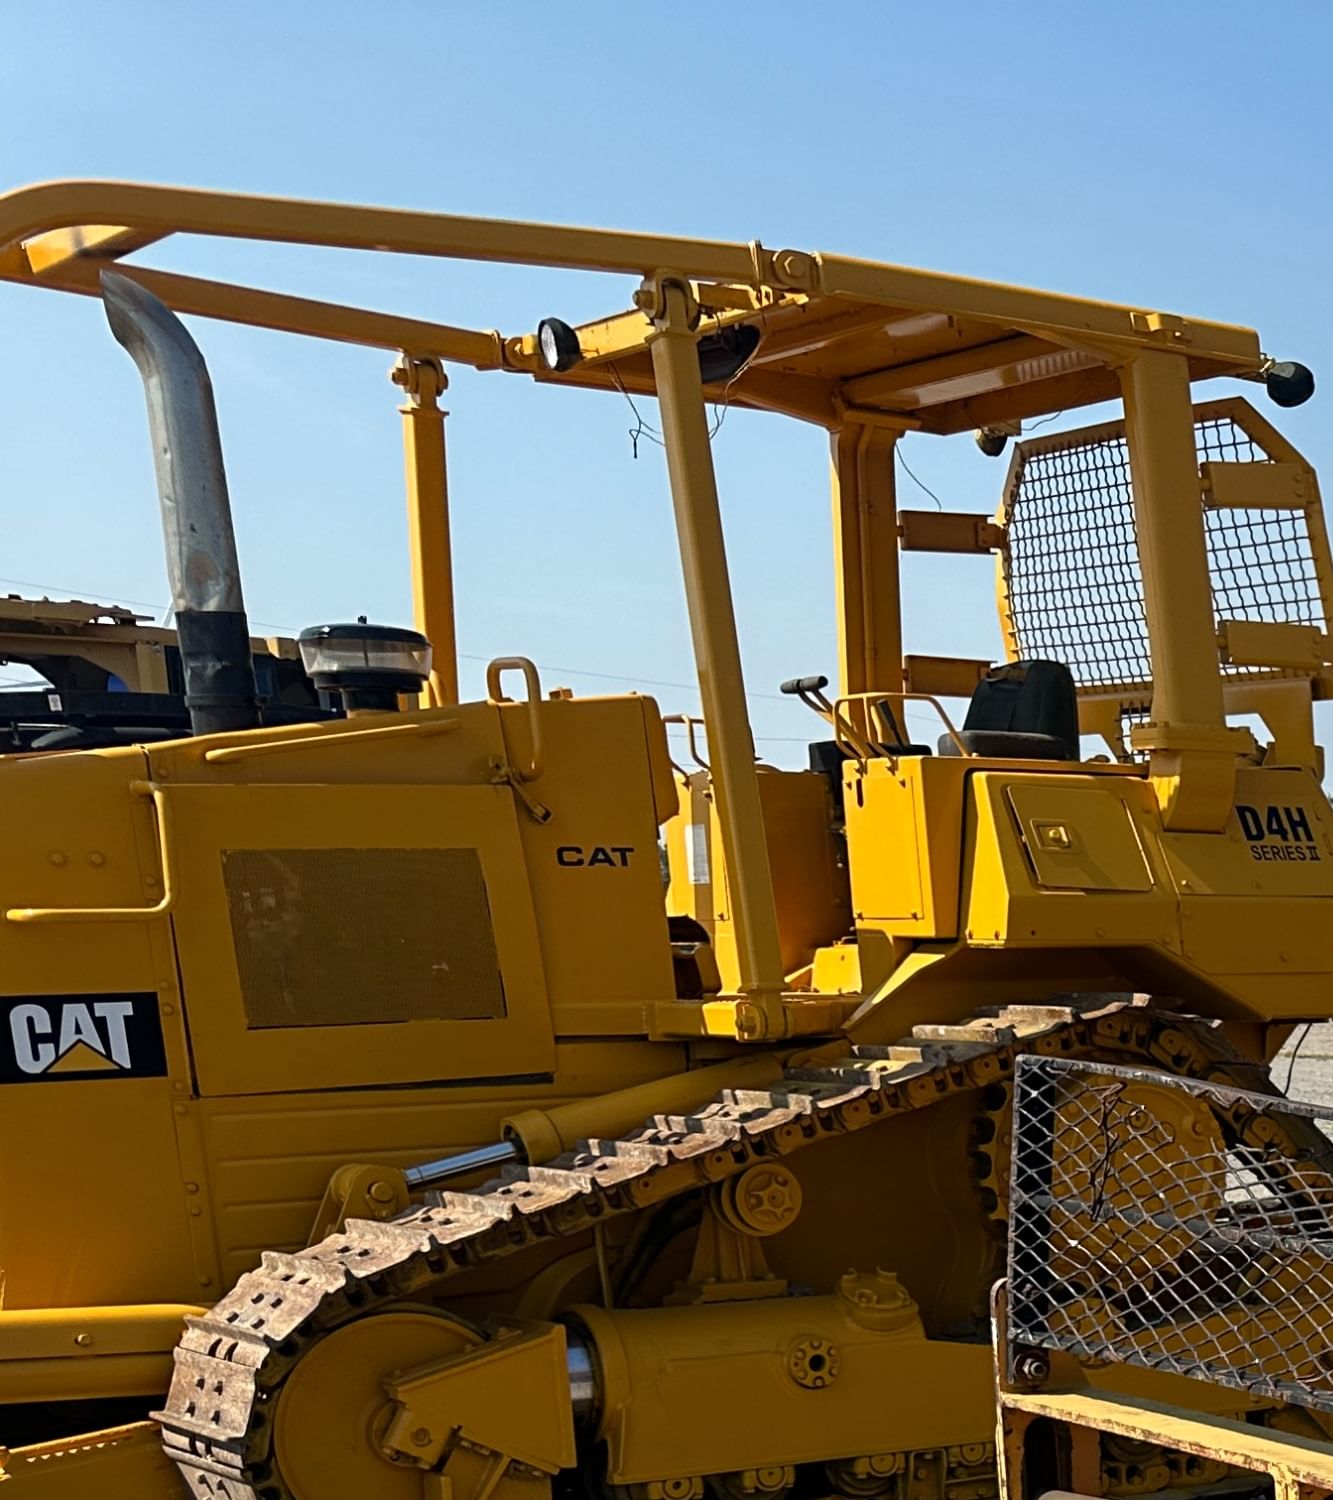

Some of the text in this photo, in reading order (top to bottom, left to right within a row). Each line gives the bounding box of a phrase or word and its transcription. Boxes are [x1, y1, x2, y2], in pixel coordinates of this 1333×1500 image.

[1236, 805, 1314, 841] D4H
[556, 846, 634, 867] CAT
[1250, 845, 1306, 861] SERIES
[9, 1001, 134, 1074] CAT
